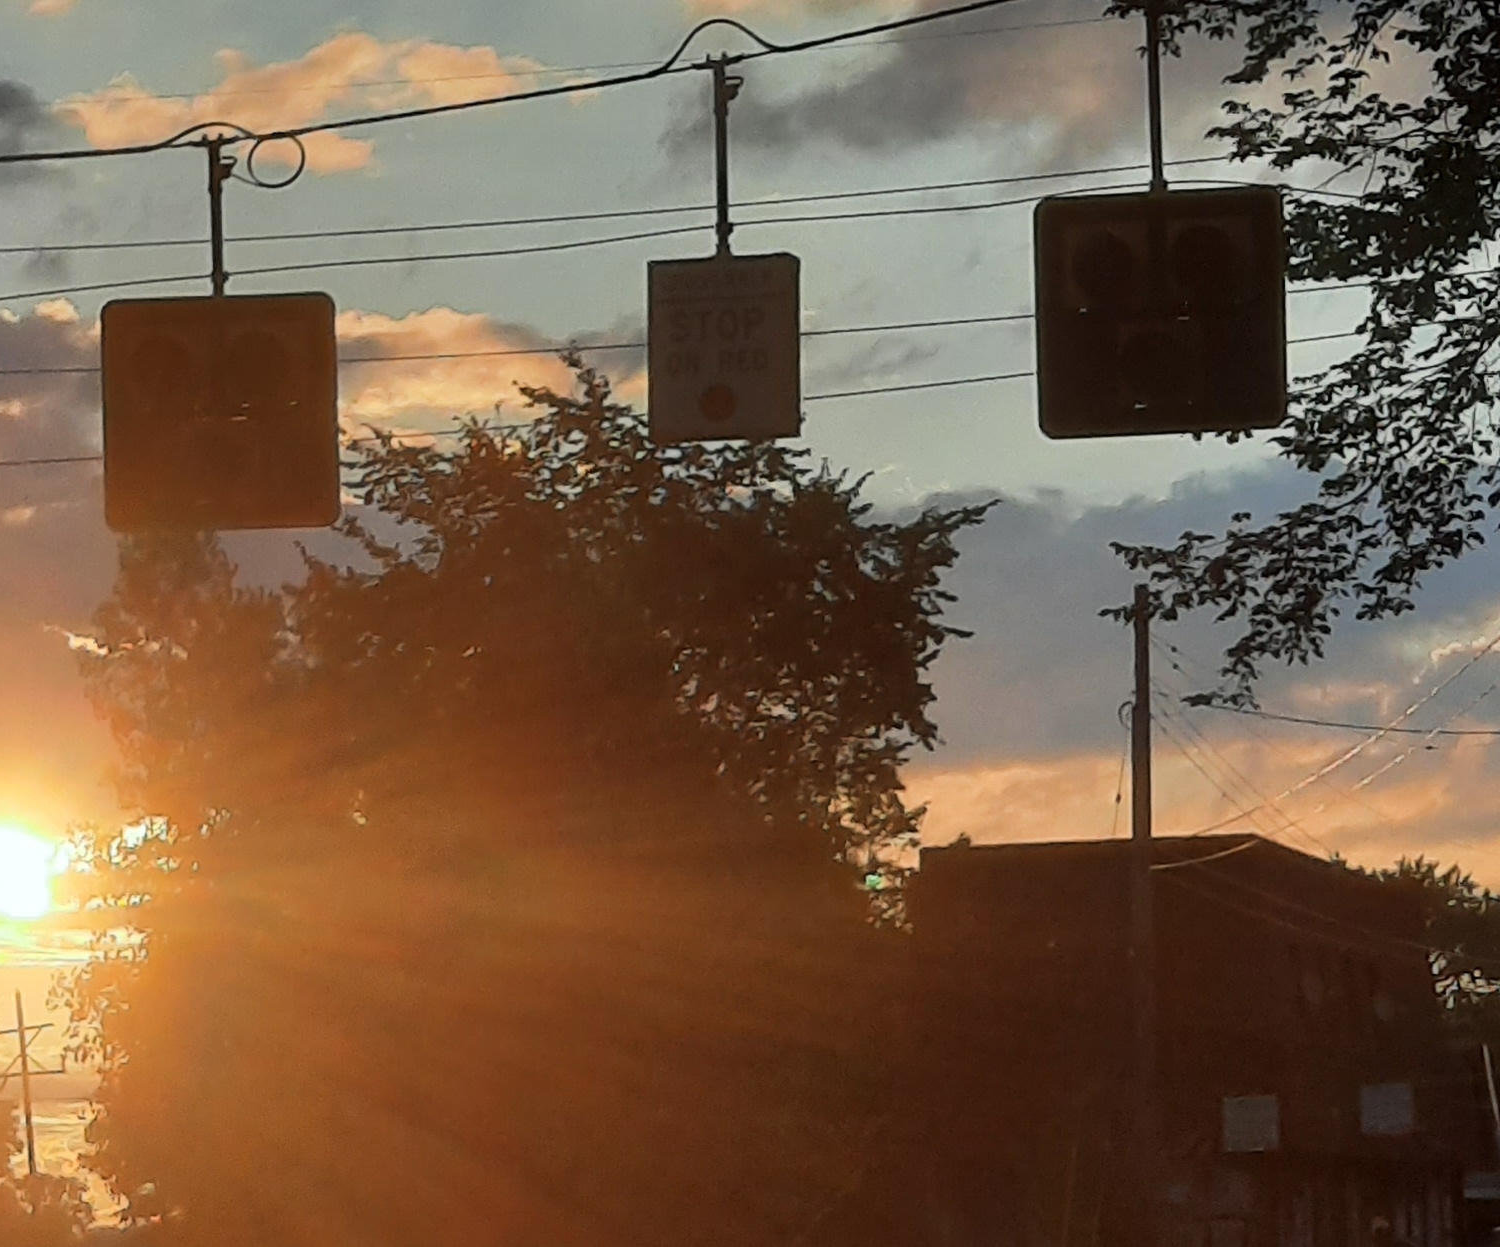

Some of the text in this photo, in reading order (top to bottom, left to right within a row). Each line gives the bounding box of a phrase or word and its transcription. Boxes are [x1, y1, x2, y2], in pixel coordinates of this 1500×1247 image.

[669, 307, 766, 342] STOP
[666, 348, 769, 375] ON RED
